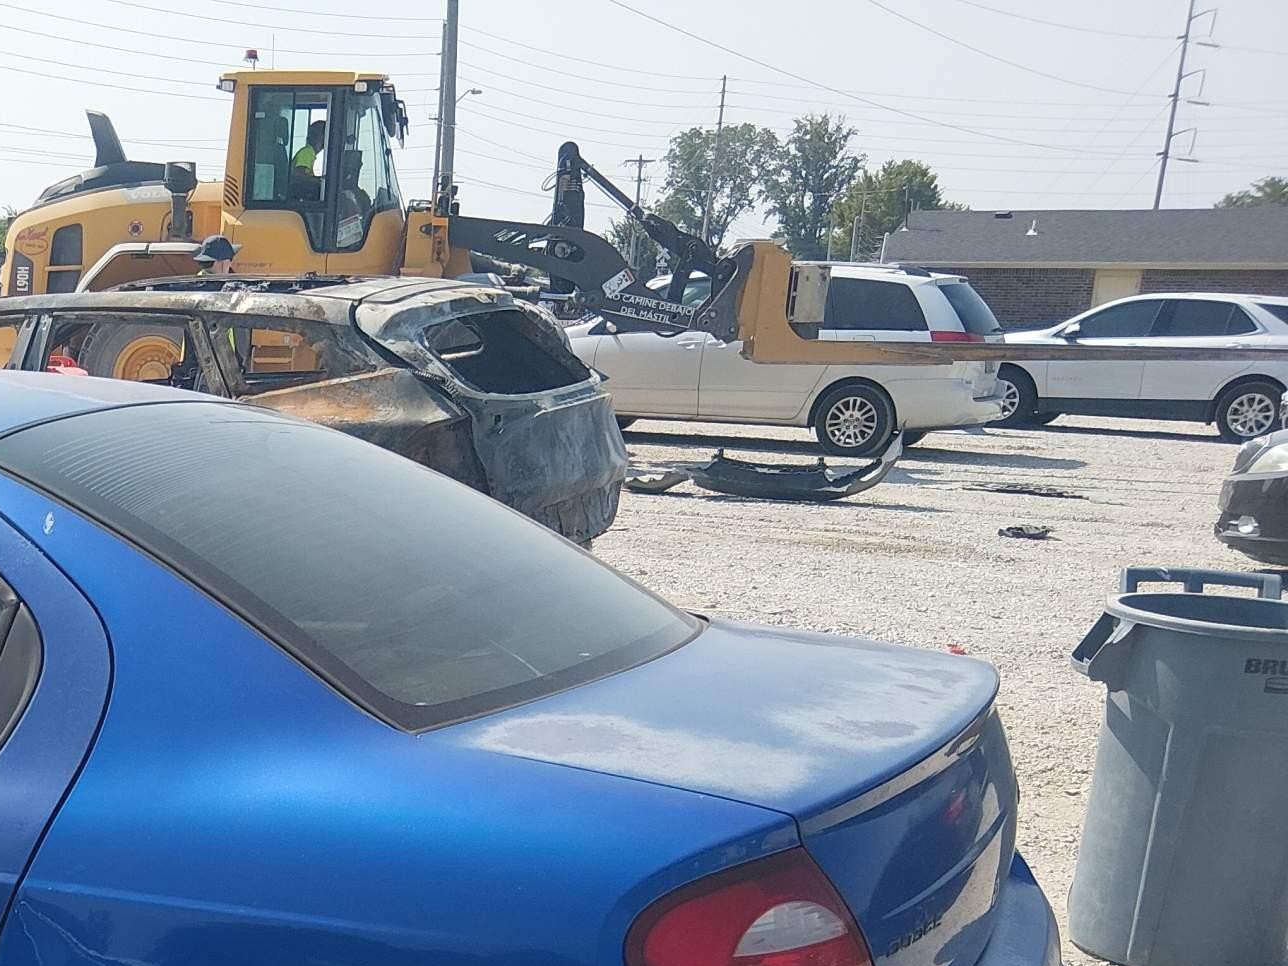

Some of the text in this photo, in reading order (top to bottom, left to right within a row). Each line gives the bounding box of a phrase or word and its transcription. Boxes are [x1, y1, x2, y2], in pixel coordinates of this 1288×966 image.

[620, 306, 671, 324] DEL MÁSTIL
[622, 295, 658, 309] CAMINE
[659, 302, 694, 316] DEBAJO
